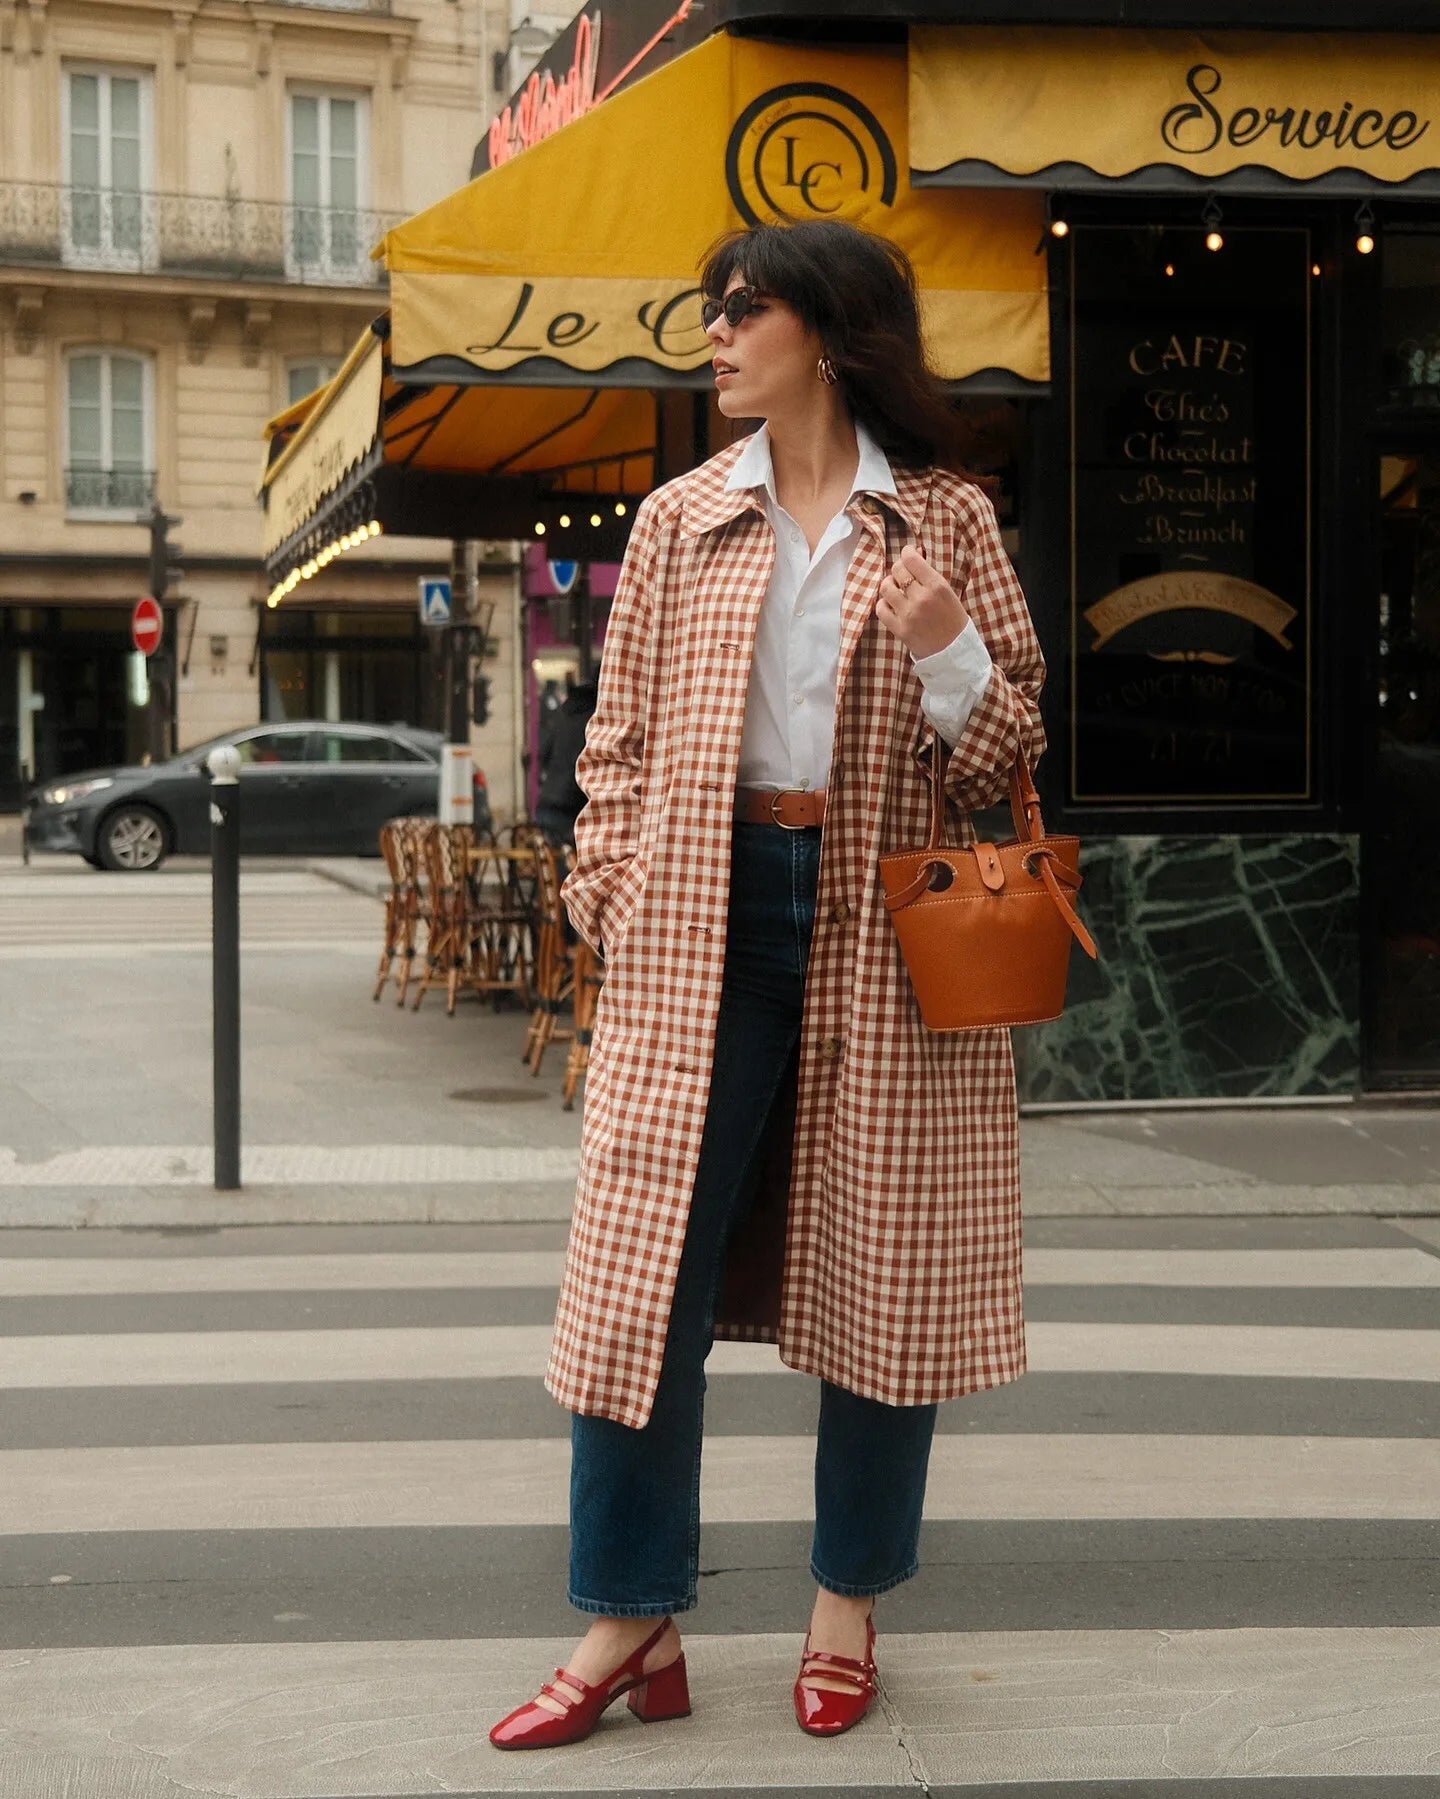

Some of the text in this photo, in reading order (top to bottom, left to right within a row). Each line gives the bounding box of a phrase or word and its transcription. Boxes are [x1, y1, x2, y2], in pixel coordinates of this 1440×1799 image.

[1161, 64, 1430, 154] Service
[466, 282, 600, 354] Le
[1128, 334, 1247, 376] CAFE
[1123, 432, 1251, 463] Chocolat
[1119, 473, 1258, 514] Breakfast
[1136, 515, 1246, 544] Brunch
